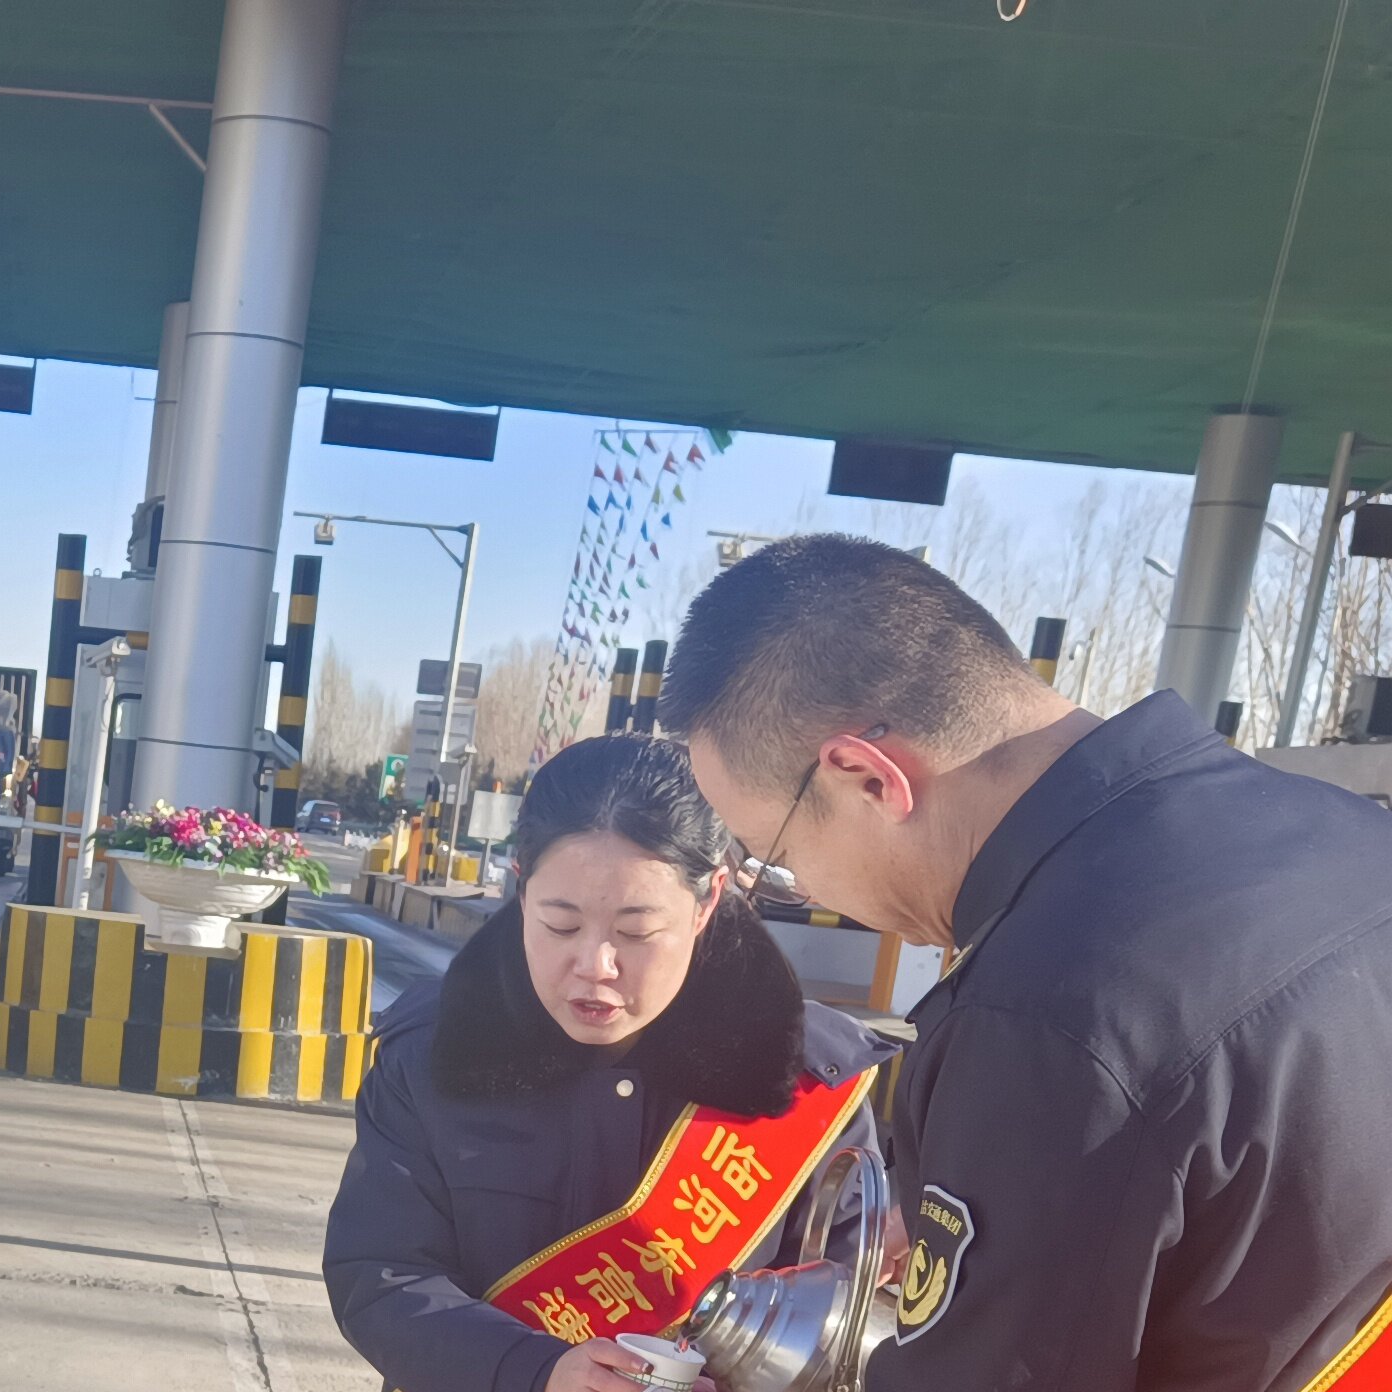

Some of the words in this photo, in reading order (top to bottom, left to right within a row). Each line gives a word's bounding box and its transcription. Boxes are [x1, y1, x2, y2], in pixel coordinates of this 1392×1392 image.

[523, 1126, 772, 1344] 临河东高速
